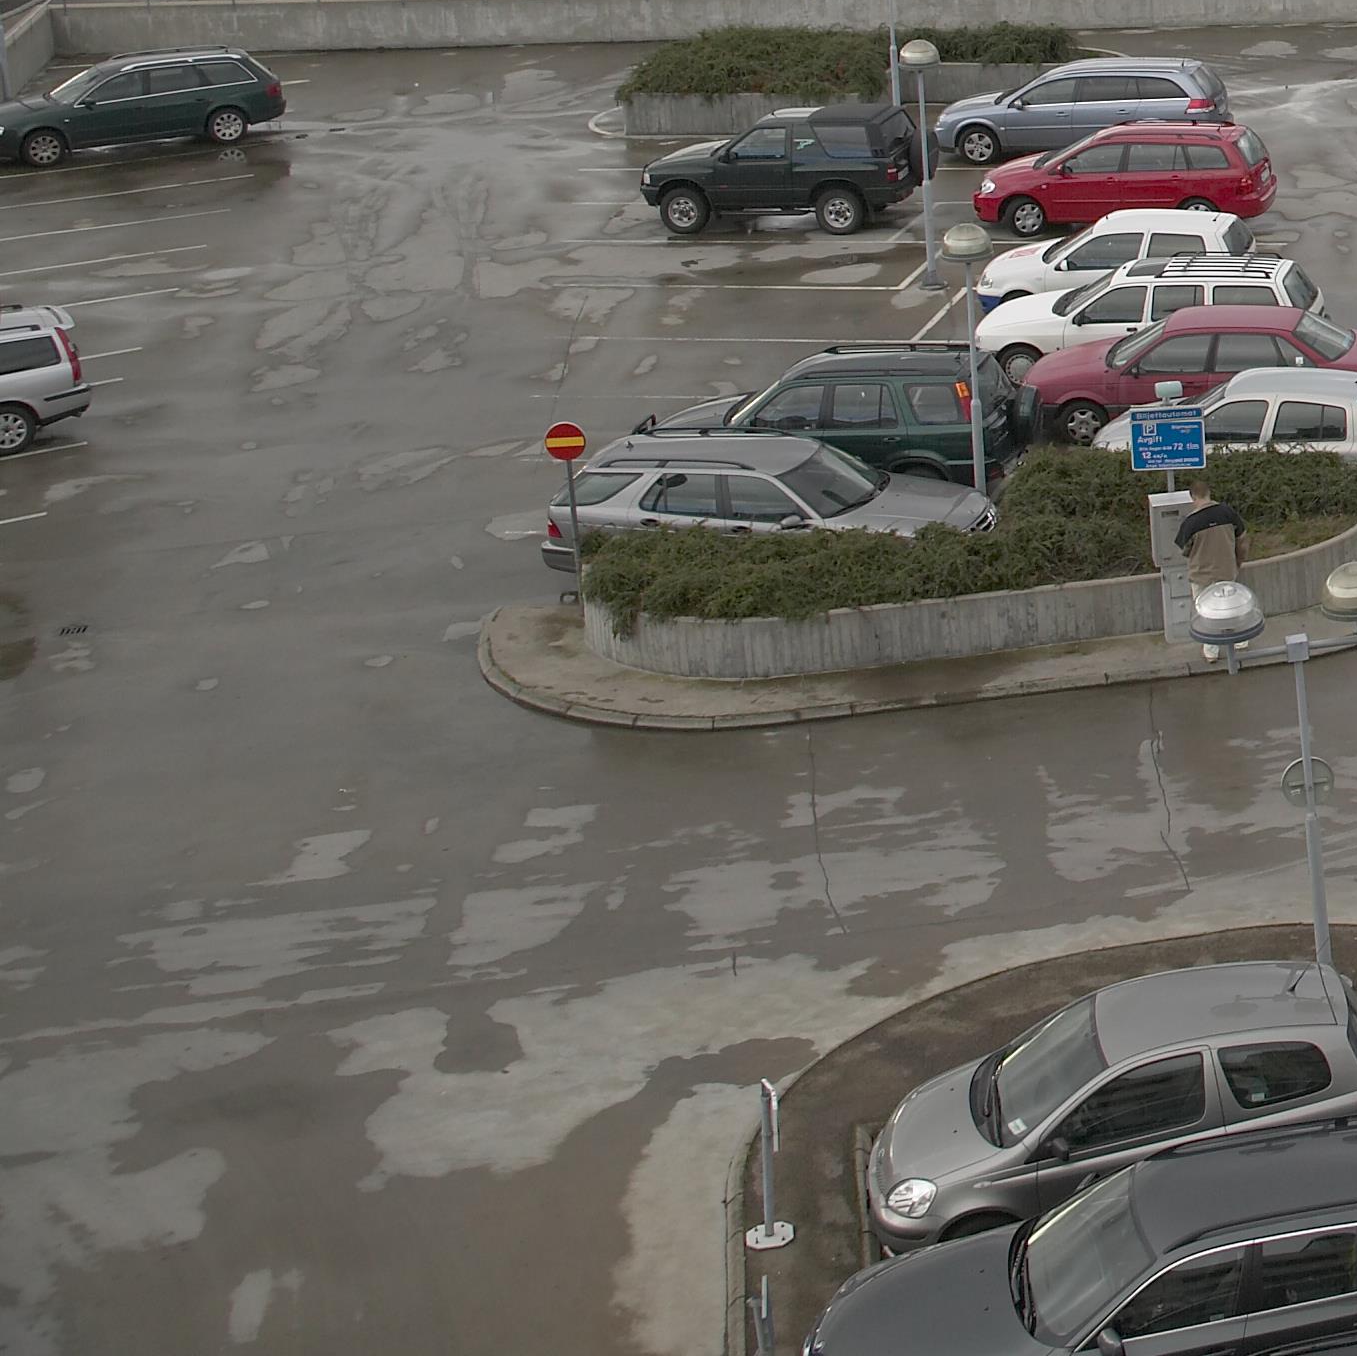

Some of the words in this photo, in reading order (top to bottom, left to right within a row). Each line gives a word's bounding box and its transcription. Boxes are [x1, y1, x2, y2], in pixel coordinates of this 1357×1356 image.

[1136, 410, 1196, 420] Biljettautomat
[1137, 436, 1162, 445] Avgift
[1172, 442, 1183, 451] 72
[1142, 451, 1152, 460] 12
